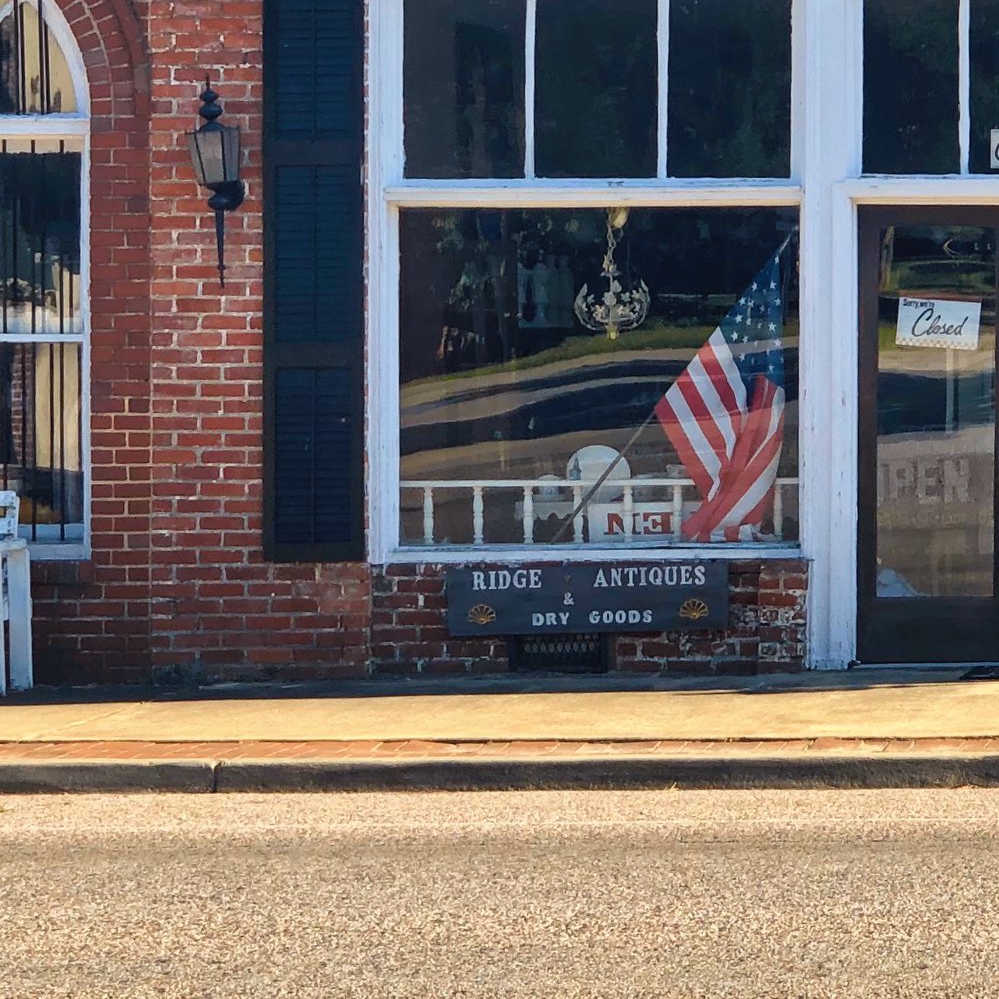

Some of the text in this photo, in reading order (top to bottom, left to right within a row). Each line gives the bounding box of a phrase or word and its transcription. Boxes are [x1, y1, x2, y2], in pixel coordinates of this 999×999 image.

[911, 307, 969, 337] Closed
[472, 565, 706, 590] RIDGE ANTIQUES
[563, 592, 575, 605] &
[532, 609, 653, 626] DRY GOODS
